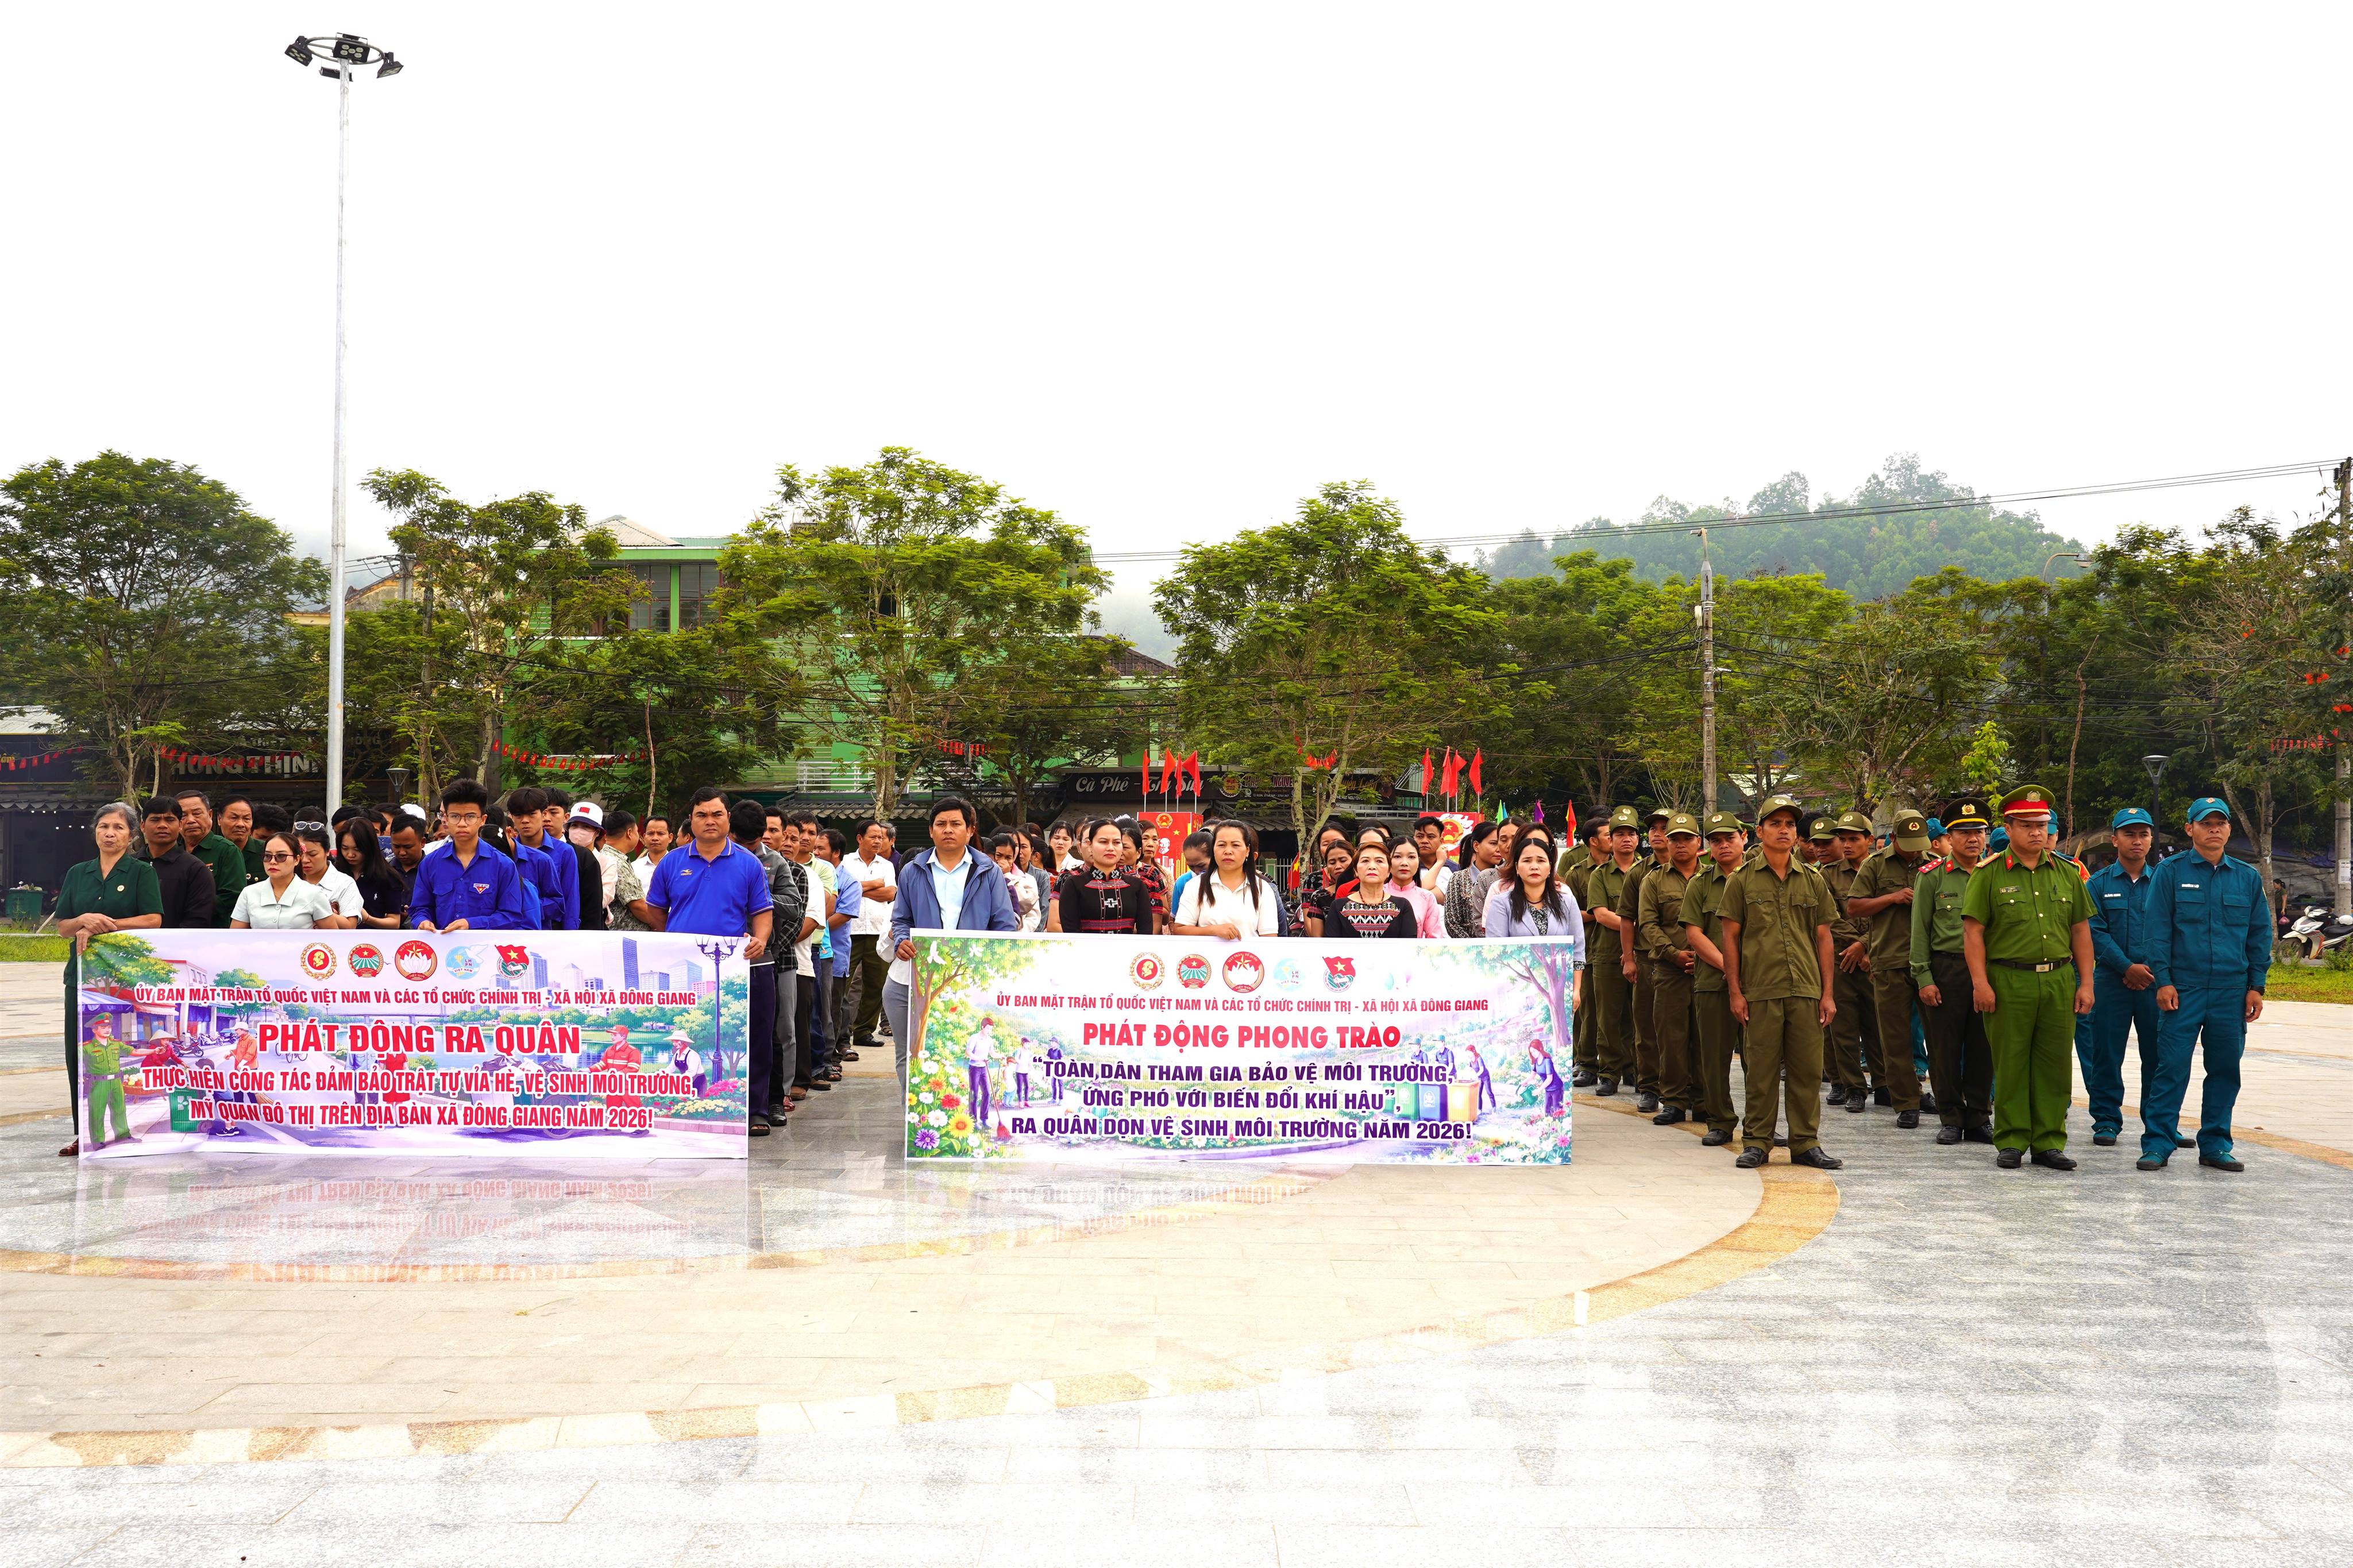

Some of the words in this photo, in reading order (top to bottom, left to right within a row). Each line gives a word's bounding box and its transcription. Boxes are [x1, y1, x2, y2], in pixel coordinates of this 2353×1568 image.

[1076, 777, 1095, 792] Cà
[1100, 776, 1130, 793] Phê
[136, 984, 153, 1001] ỦY
[157, 988, 185, 1001] BAN
[189, 986, 217, 1003] MẶT
[220, 987, 253, 1004] TRẬN
[255, 986, 271, 1002] TỔ
[274, 987, 308, 1004] QUỐC
[311, 988, 337, 1006] VIỆT
[341, 991, 371, 1003] NAM
[374, 988, 391, 1003] VÀ
[394, 988, 419, 1003] CÁC
[422, 986, 438, 1004] TỔ
[442, 989, 475, 1004] CHỨC
[479, 989, 518, 1004] CHÍNH
[522, 991, 541, 1007] TRỊ
[554, 990, 571, 1004] XÃ
[574, 989, 595, 1006] HỘI
[599, 990, 616, 1005] XÃ
[619, 989, 653, 1005] ĐÔNG
[657, 992, 696, 1005] GIANG
[997, 991, 1010, 1006] ỦY
[1015, 995, 1037, 1007] BAN
[1041, 994, 1064, 1010] MẶT
[1067, 994, 1096, 1010] TRẬN
[1100, 993, 1113, 1009] TỔ
[1116, 994, 1145, 1010] QUỐC
[1150, 997, 1172, 1012] VIỆT
[1175, 999, 1201, 1010] NAM
[1205, 997, 1218, 1011] VÀ
[1222, 998, 1244, 1011] CÁC
[1247, 995, 1260, 1011] TỔ
[1264, 998, 1293, 1011] CHỨC
[1297, 998, 1330, 1011] CHÍNH
[1334, 1001, 1351, 1014] TRỊ
[1363, 999, 1377, 1011] XÃ
[1381, 998, 1399, 1014] HỘI
[1403, 999, 1417, 1011] XÃ
[1421, 998, 1451, 1011] ĐÔNG
[1455, 999, 1488, 1011] GIANG
[259, 1019, 340, 1052] PHÁT
[349, 1019, 434, 1058] ĐỘNG
[445, 1026, 485, 1053] RA
[495, 1021, 580, 1056] QUÂN
[1083, 1019, 1146, 1046] PHÁT
[1154, 1019, 1229, 1053] ĐỘNG
[1238, 1026, 1328, 1049] PHONG
[1336, 1022, 1401, 1048] TRÀO
[142, 1067, 186, 1090] THỰC
[188, 1068, 225, 1092] HIỆN
[229, 1068, 275, 1091] CÔNG
[280, 1067, 311, 1091] TÁC
[315, 1065, 353, 1091] ĐẢM
[358, 1066, 391, 1091] BẢO
[395, 1068, 435, 1095] TRẬT
[439, 1070, 461, 1095] TỰ
[464, 1065, 490, 1092] VỈA
[495, 1069, 519, 1094] HÈ,
[524, 1069, 544, 1097] VỆ
[549, 1073, 587, 1093] SINH
[593, 1070, 623, 1094] MÔI
[628, 1070, 696, 1098] TRƯỜNG,
[1101, 1061, 1141, 1080] DÂN
[1147, 1065, 1202, 1081] THAM
[1210, 1066, 1243, 1082] GIA
[1249, 1061, 1287, 1081] BẢO
[1294, 1063, 1317, 1084] VỆ
[1324, 1061, 1361, 1081] MÔI
[1368, 1061, 1453, 1084] TRƯỜNG,
[1083, 1086, 1123, 1106] ỨNG
[1130, 1088, 1169, 1107] PHÓ
[1175, 1088, 1206, 1107] VỚI
[1214, 1087, 1259, 1108] BIẾN
[1265, 1086, 1298, 1109] ĐỔI
[1305, 1090, 1337, 1109] KHÍ
[190, 1098, 213, 1119] MỸ
[218, 1102, 260, 1122] QUAN
[262, 1102, 284, 1124] ĐÔ
[288, 1106, 314, 1129] THỊ
[319, 1101, 362, 1125] TRÊN
[367, 1106, 394, 1129] ĐỊA
[398, 1102, 432, 1125] BÀN
[437, 1102, 458, 1125] XÃ
[462, 1102, 507, 1126] ĐÔNG
[512, 1106, 561, 1127] GIANG
[566, 1104, 604, 1127] NĂM
[608, 1108, 653, 1128] 2026!
[1012, 1118, 1037, 1134] RA
[1044, 1114, 1097, 1136] QUÂN
[1104, 1118, 1144, 1139] DỌN
[1151, 1116, 1174, 1140] VỆ
[1181, 1119, 1228, 1136] SINH
[1235, 1117, 1272, 1137] MÔI
[1279, 1117, 1357, 1138] TRƯỜNG
[1364, 1119, 1410, 1138] NĂM
[1416, 1123, 1471, 1140] 2026!
